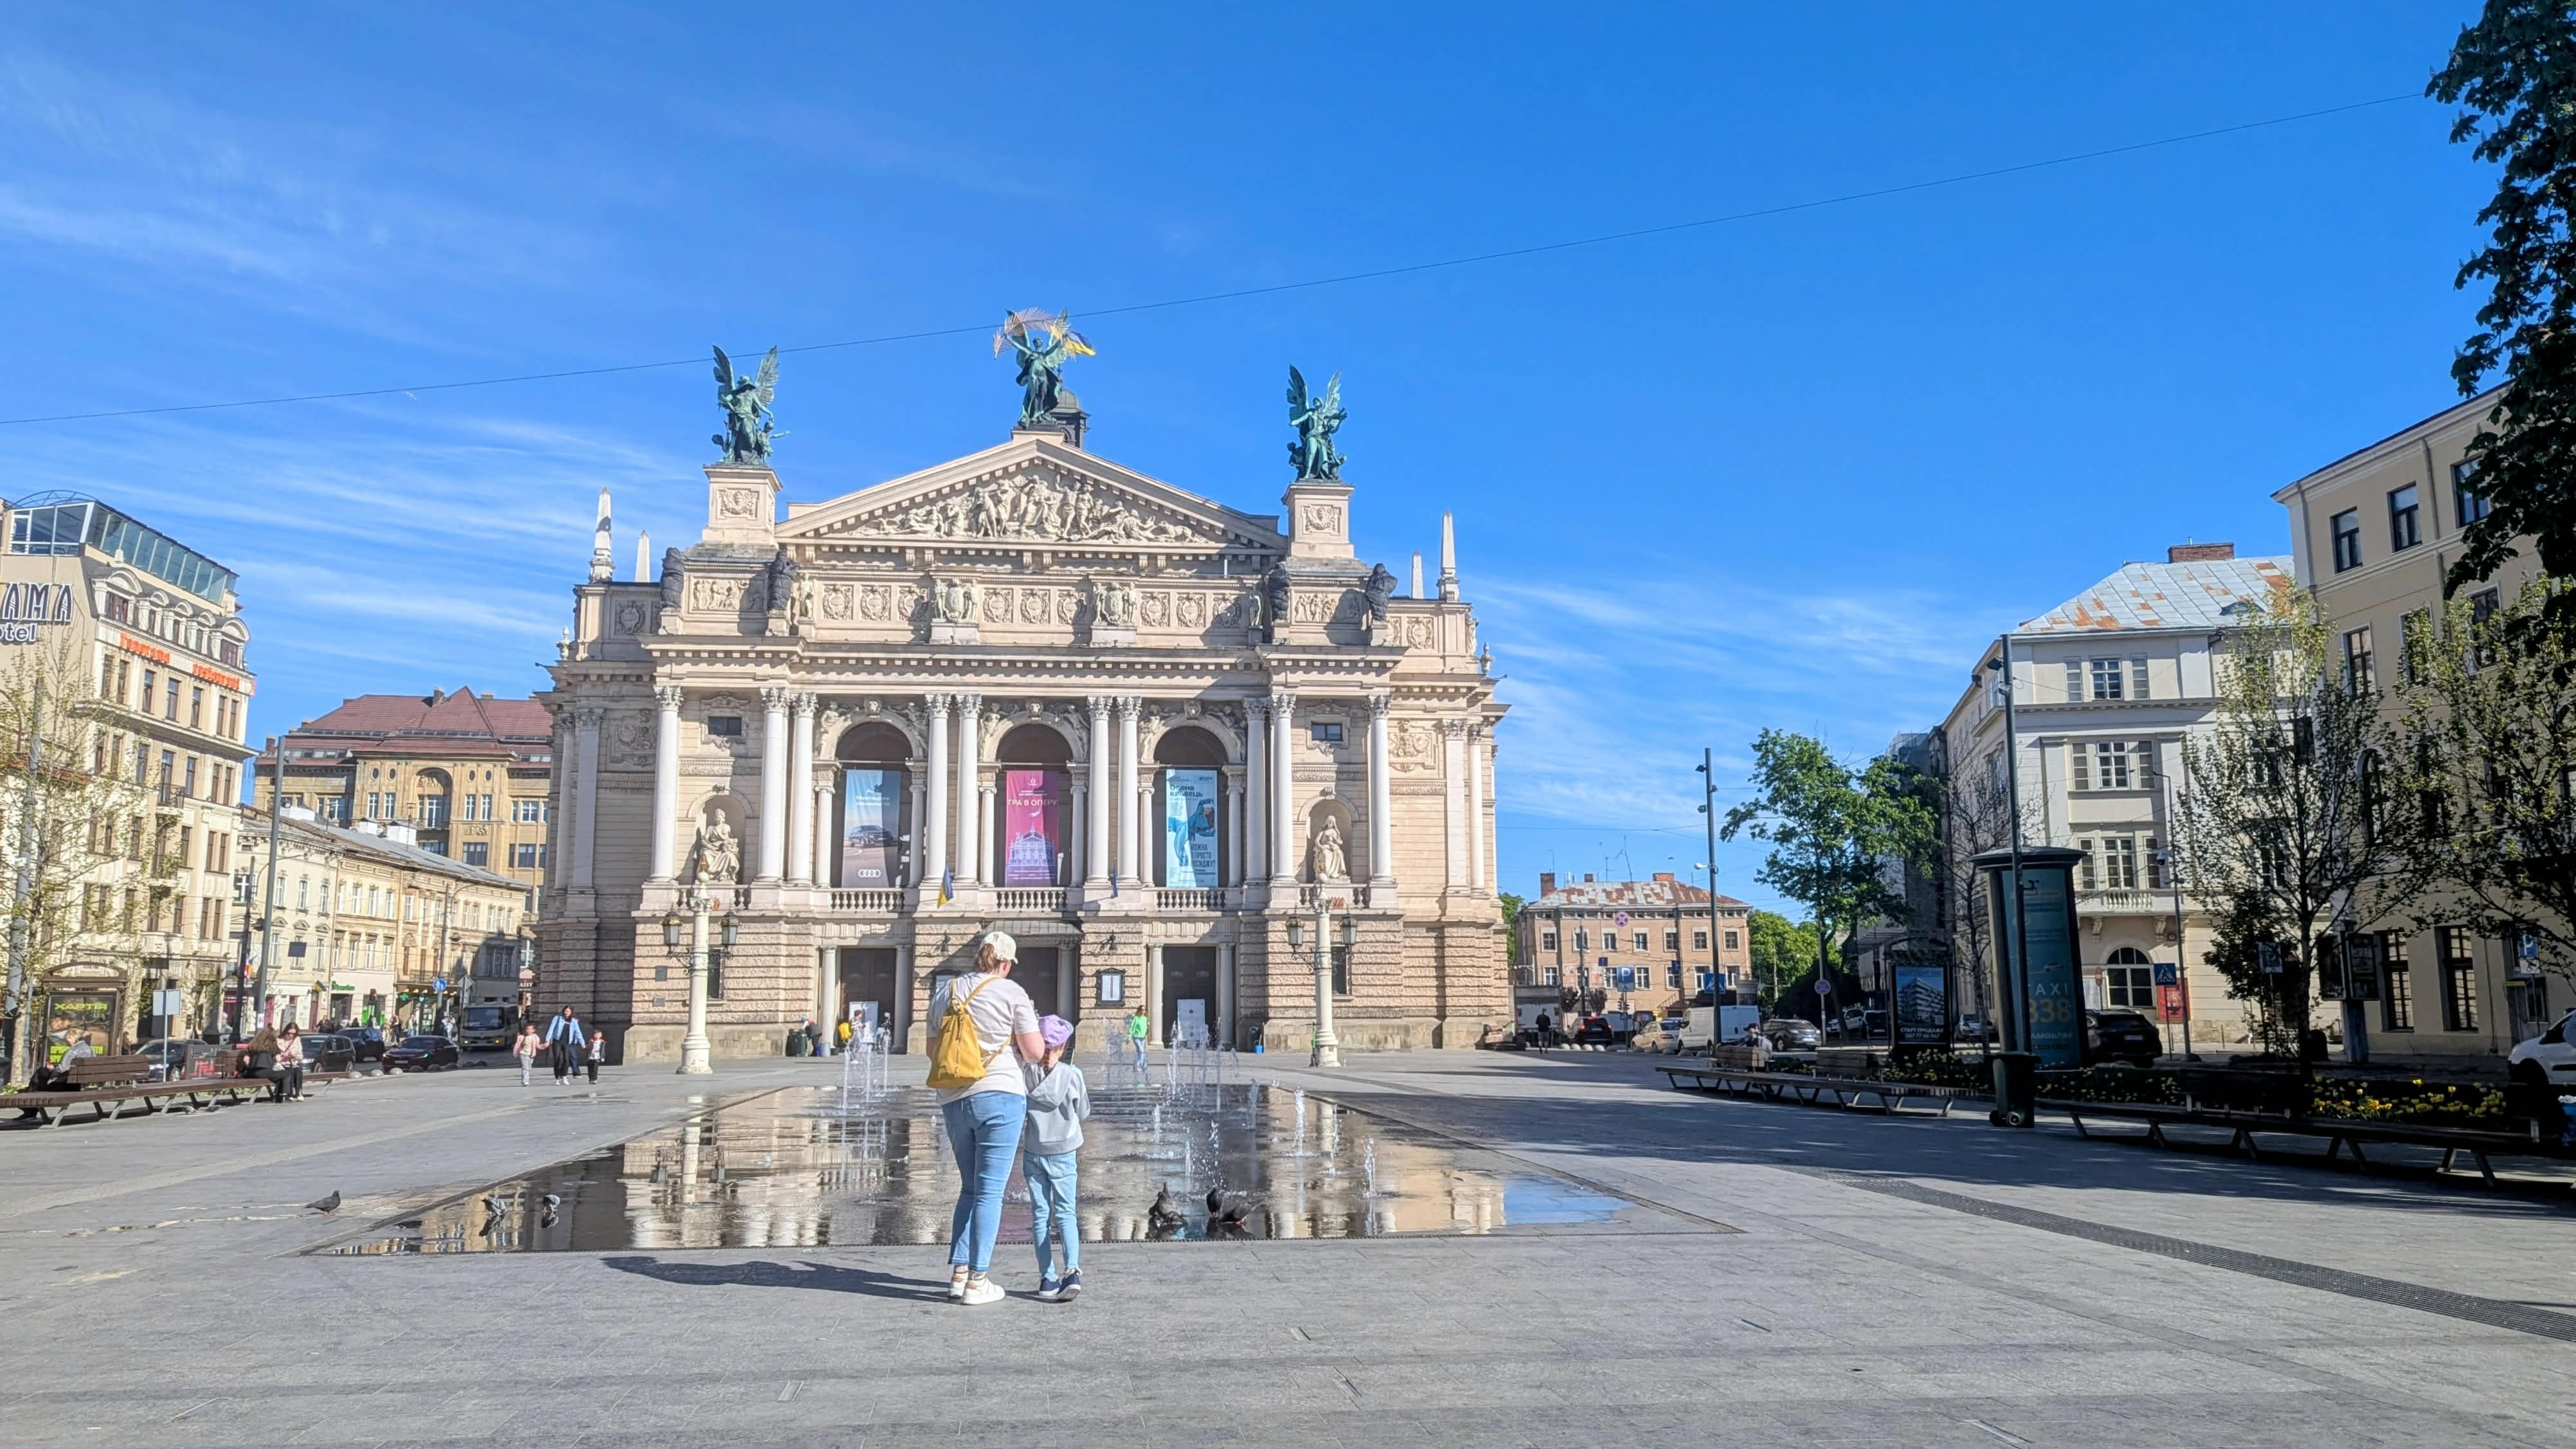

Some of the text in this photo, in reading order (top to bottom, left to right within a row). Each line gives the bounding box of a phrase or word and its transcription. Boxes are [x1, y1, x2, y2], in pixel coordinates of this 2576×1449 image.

[0, 622, 37, 642] tel
[1621, 967, 1631, 982] P
[2027, 983, 2068, 996] AXI
